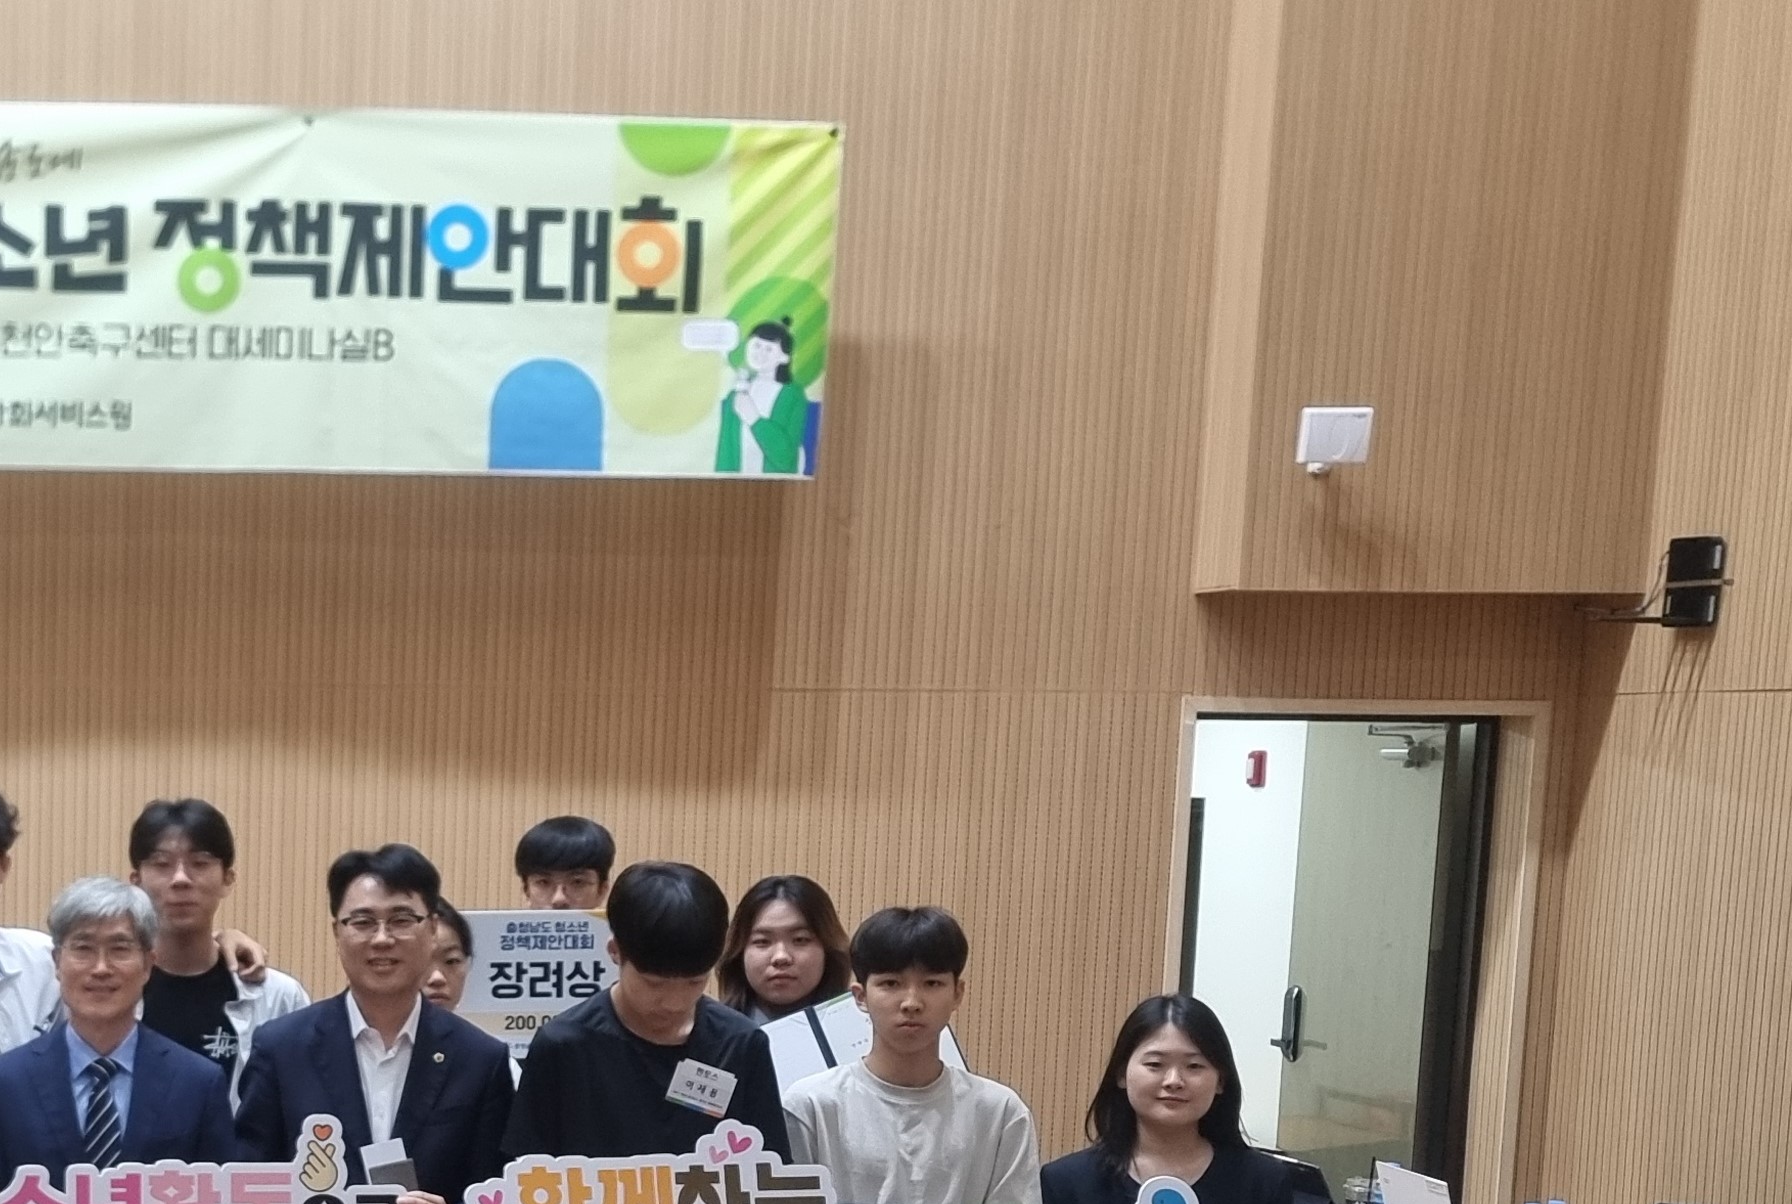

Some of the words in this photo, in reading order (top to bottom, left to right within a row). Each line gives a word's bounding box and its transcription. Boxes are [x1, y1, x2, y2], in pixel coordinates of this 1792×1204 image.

[153, 195, 702, 314] 정책제안대회
[3, 320, 198, 360] 천안축구센터
[208, 324, 396, 362] 대세미나실B
[500, 934, 595, 951] 정책제안대회
[489, 960, 606, 999] 장려상
